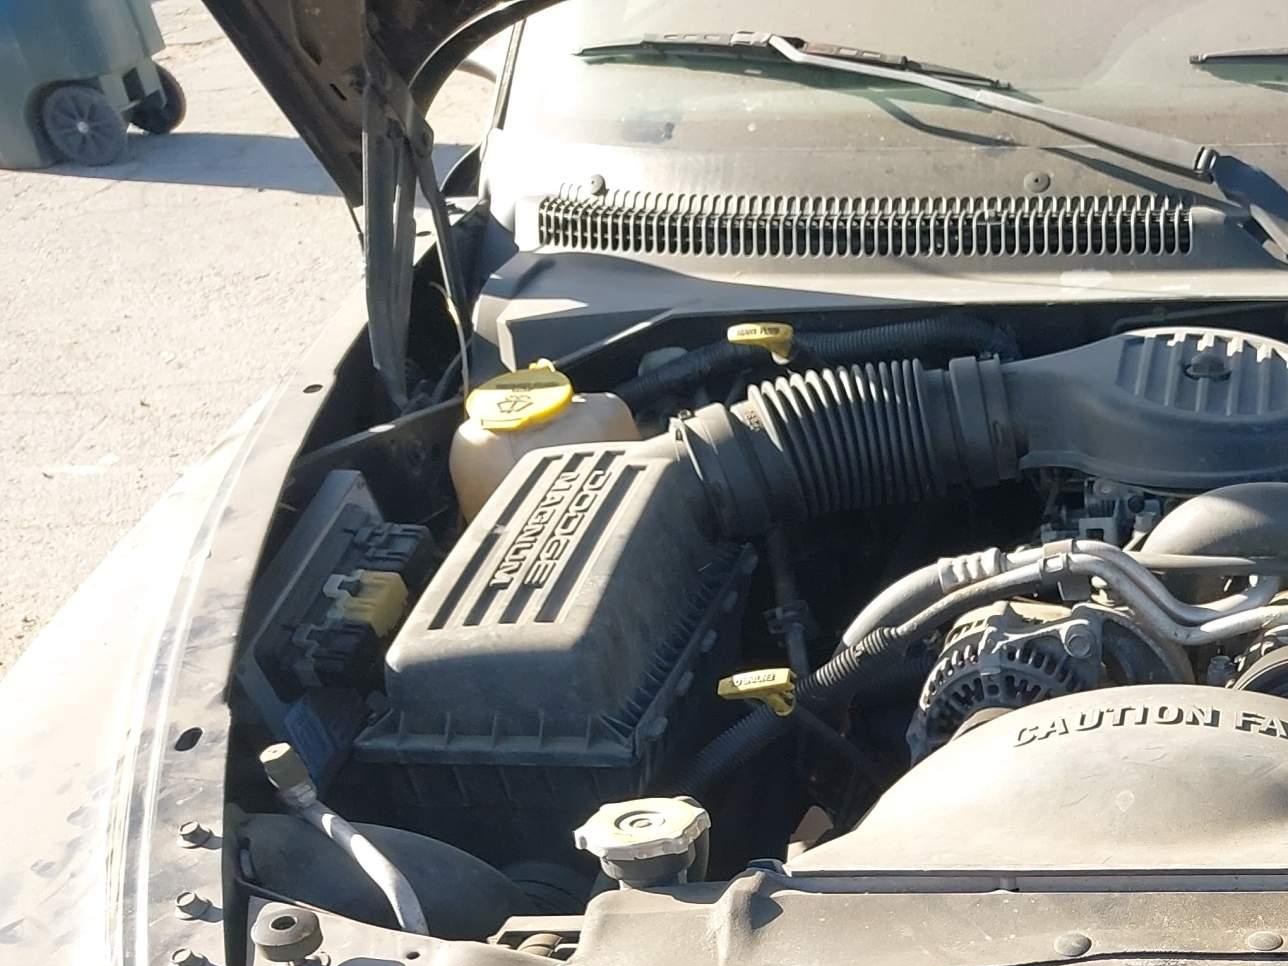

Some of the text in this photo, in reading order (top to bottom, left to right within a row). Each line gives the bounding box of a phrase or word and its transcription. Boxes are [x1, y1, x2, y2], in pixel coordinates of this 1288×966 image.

[488, 471, 580, 591] MAGNUM
[523, 470, 612, 588] DODGE
[1013, 702, 1219, 748] CAUTION
